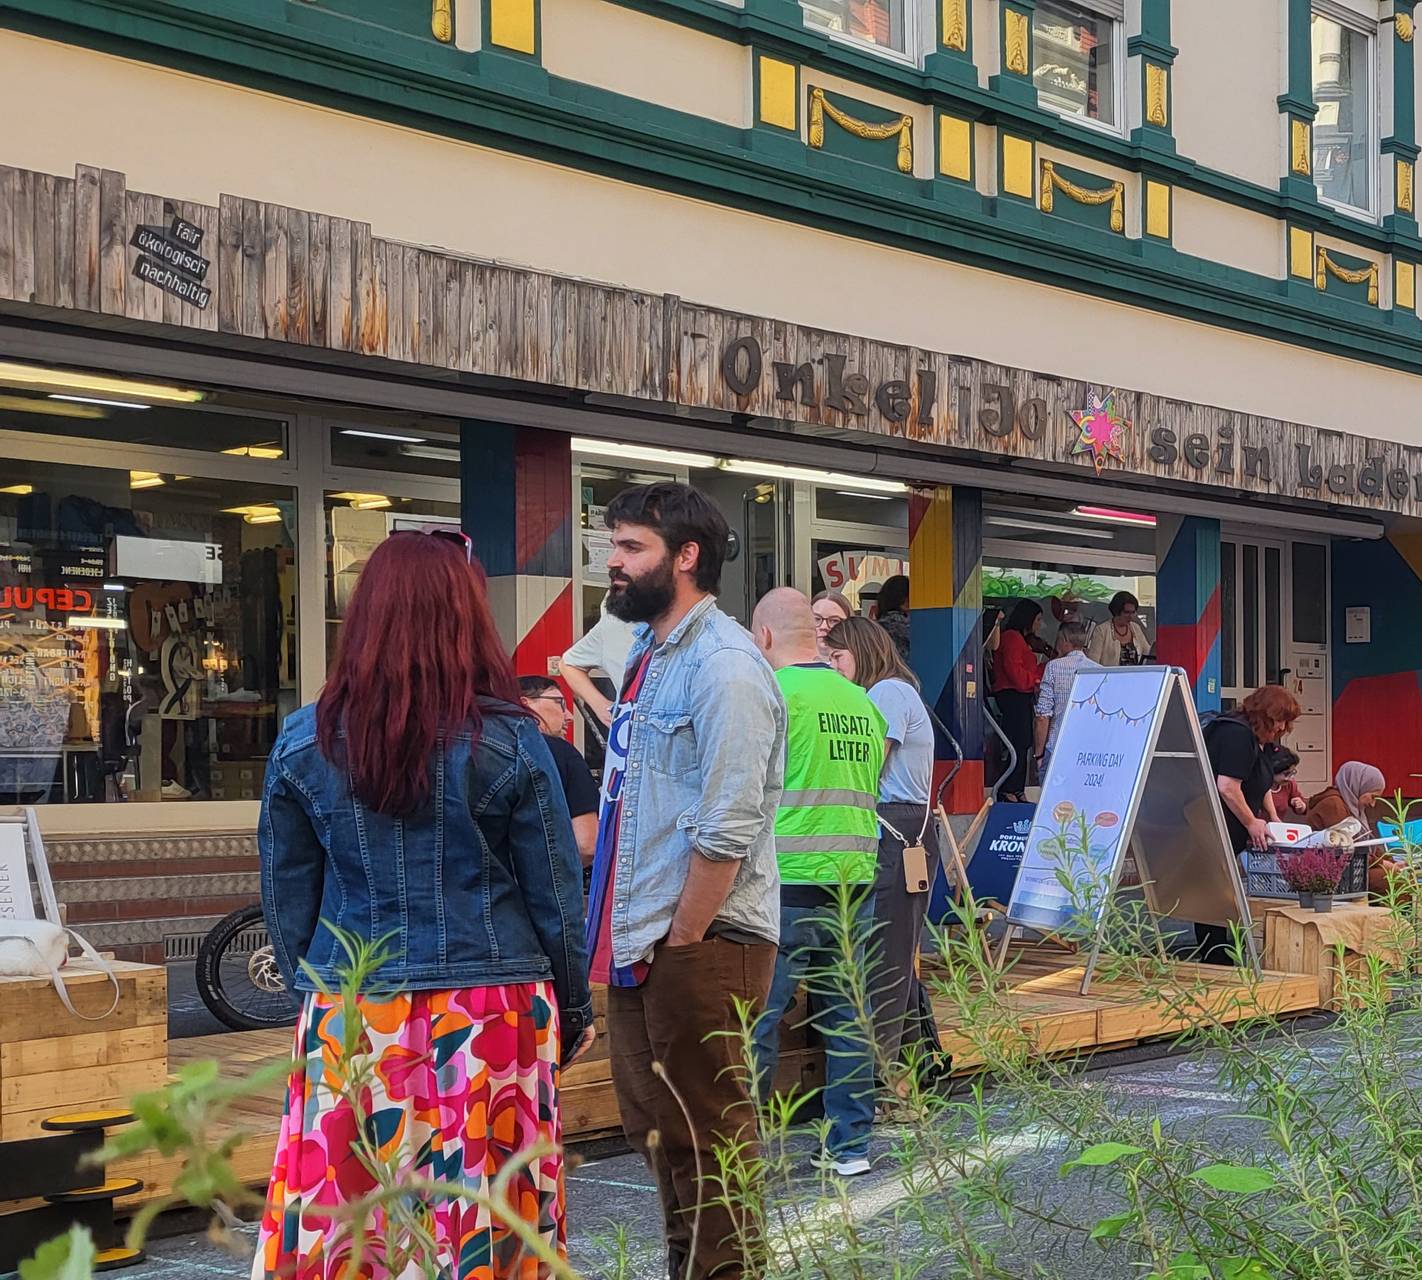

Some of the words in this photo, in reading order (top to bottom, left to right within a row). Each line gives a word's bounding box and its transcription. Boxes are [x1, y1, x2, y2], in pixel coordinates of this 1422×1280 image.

[176, 222, 201, 244] fair
[138, 230, 206, 274] ökologisch
[140, 262, 208, 308] nachhaltig
[722, 336, 937, 425] Onkel
[980, 383, 1047, 440] Jo
[1149, 424, 1272, 483] sein
[829, 739, 870, 762] LEITER
[1076, 752, 1108, 767] PARKING
[1108, 753, 1124, 767] DAY
[1084, 772, 1105, 787] 2024!
